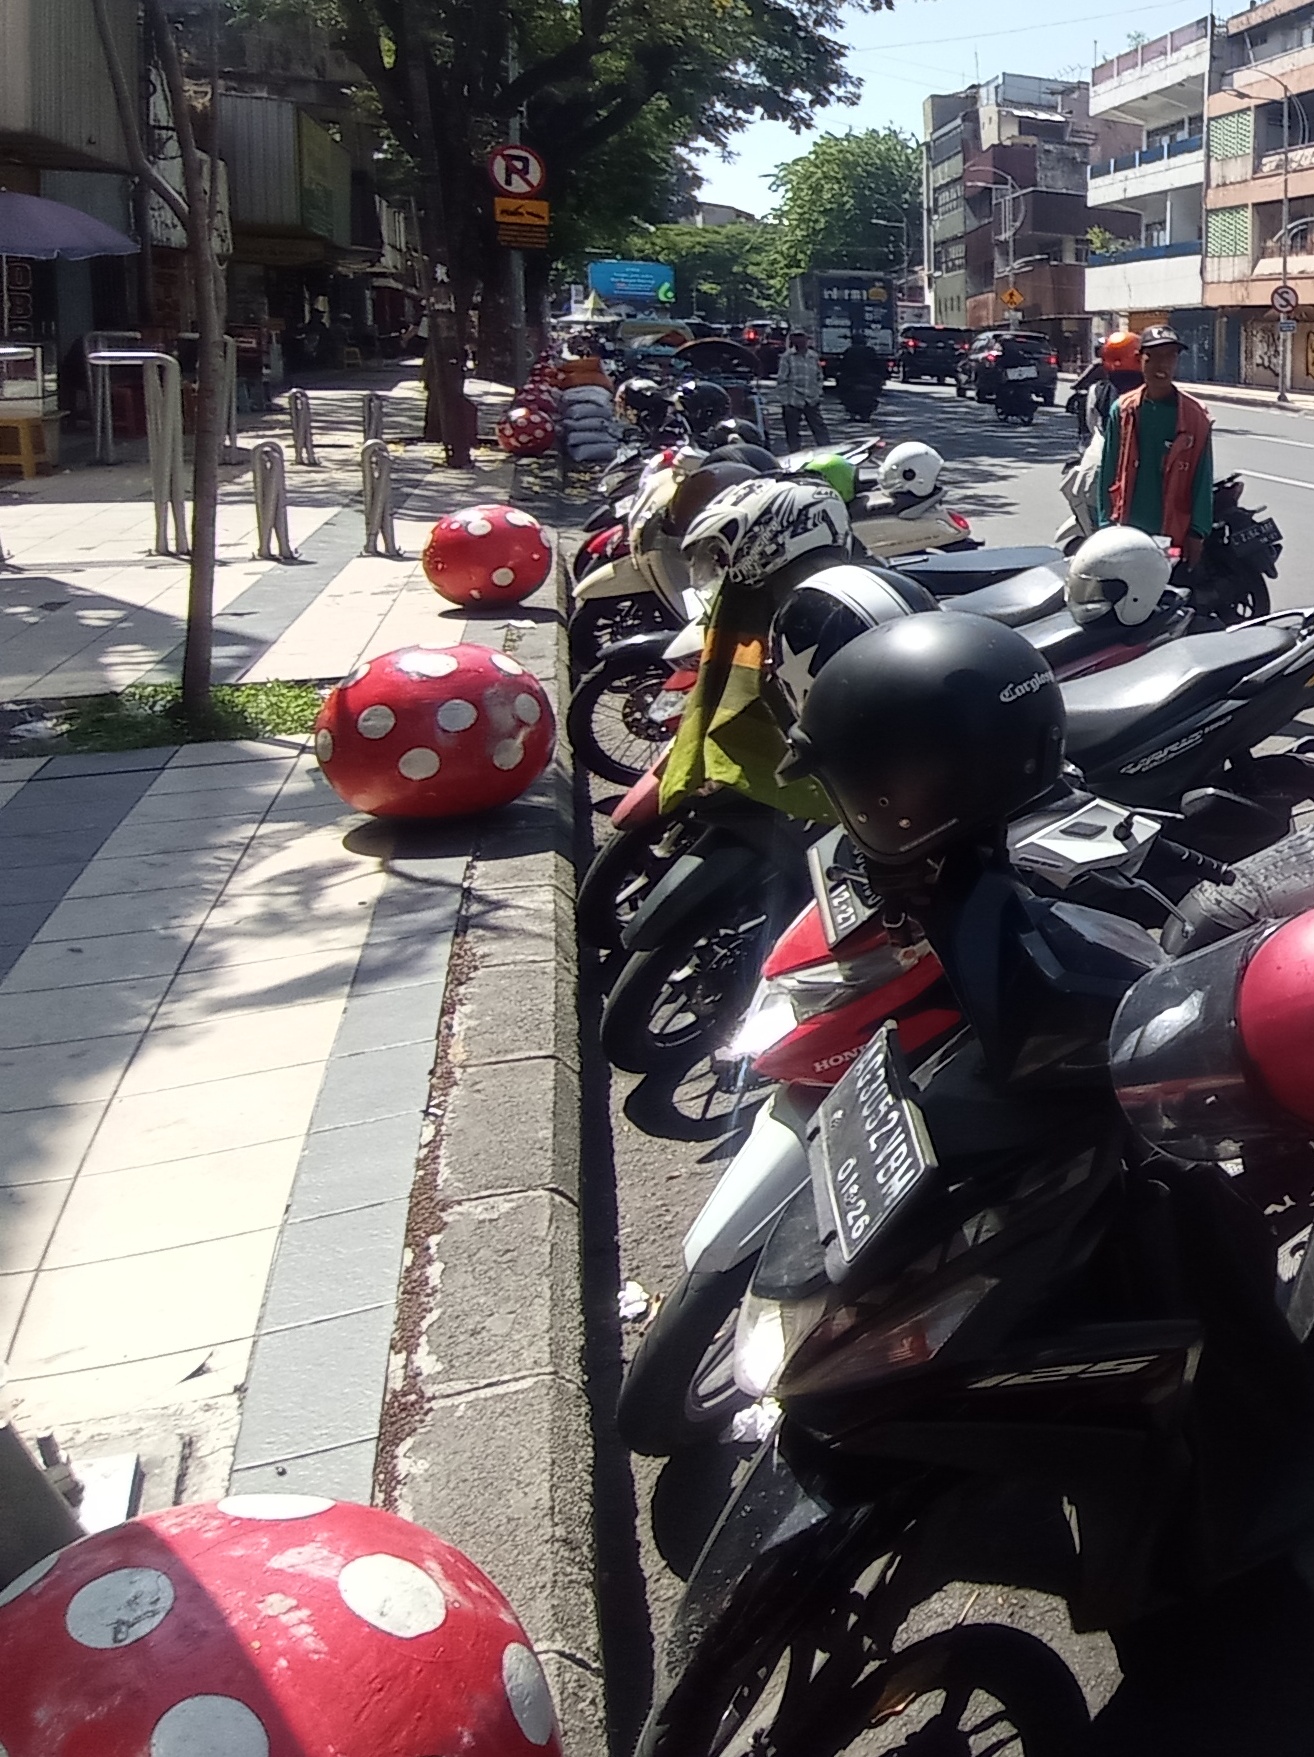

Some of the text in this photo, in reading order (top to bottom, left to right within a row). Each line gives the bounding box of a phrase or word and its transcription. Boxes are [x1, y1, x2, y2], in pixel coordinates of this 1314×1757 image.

[812, 1043, 868, 1074] HON
[858, 1067, 900, 1152] 3052
[874, 1125, 916, 1207] VBM
[966, 1354, 1161, 1389] 125
